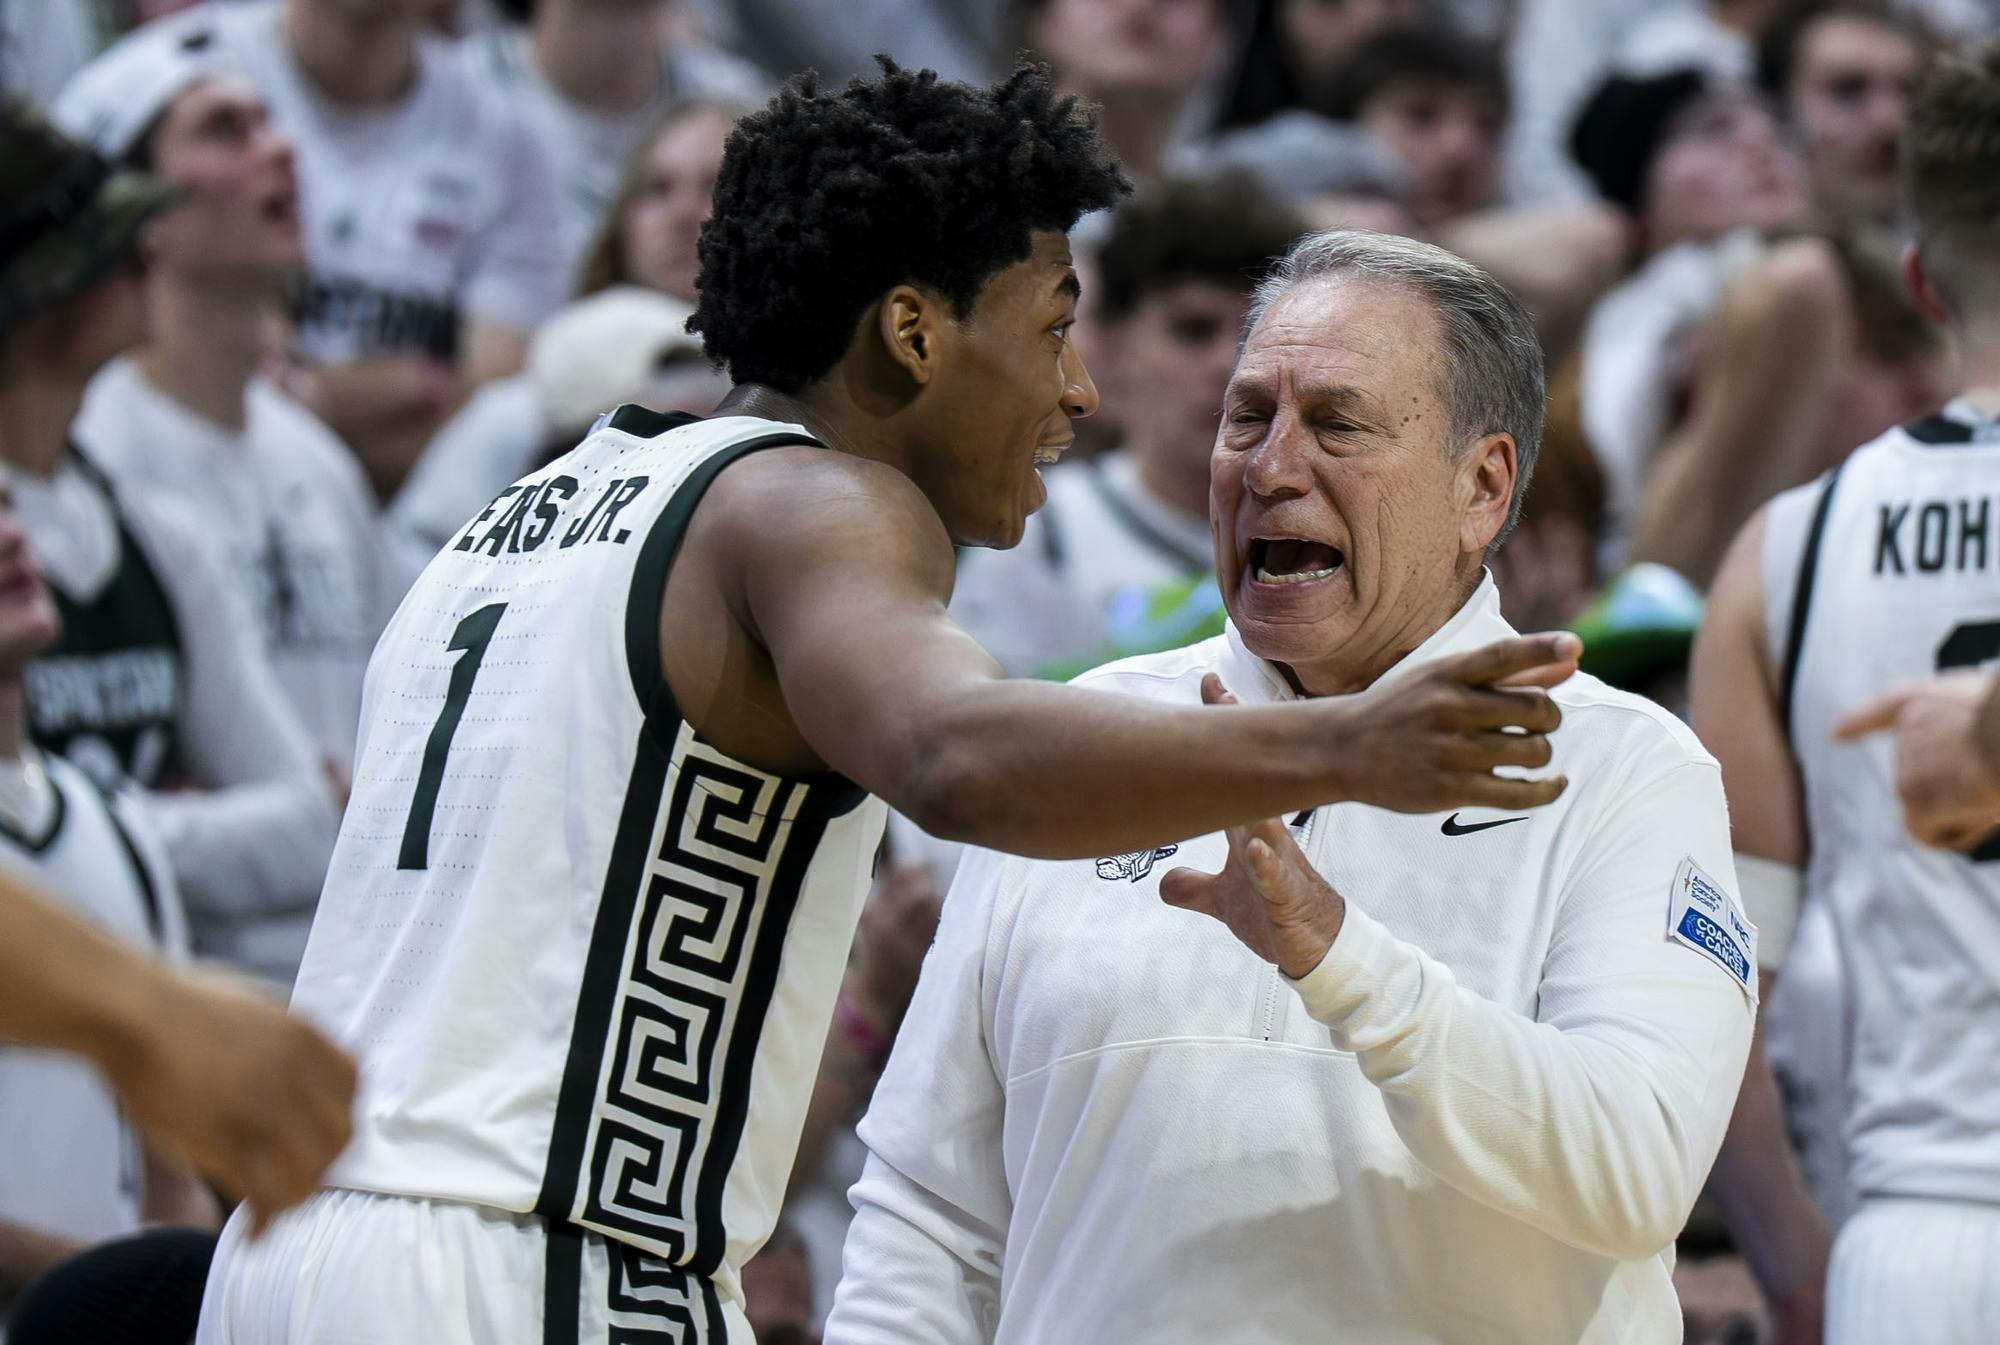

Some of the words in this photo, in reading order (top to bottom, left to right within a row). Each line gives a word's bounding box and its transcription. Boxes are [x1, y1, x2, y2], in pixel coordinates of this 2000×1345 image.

[559, 475, 650, 549] JR.
[1875, 498, 2000, 575] KOH
[397, 602, 509, 870] 1
